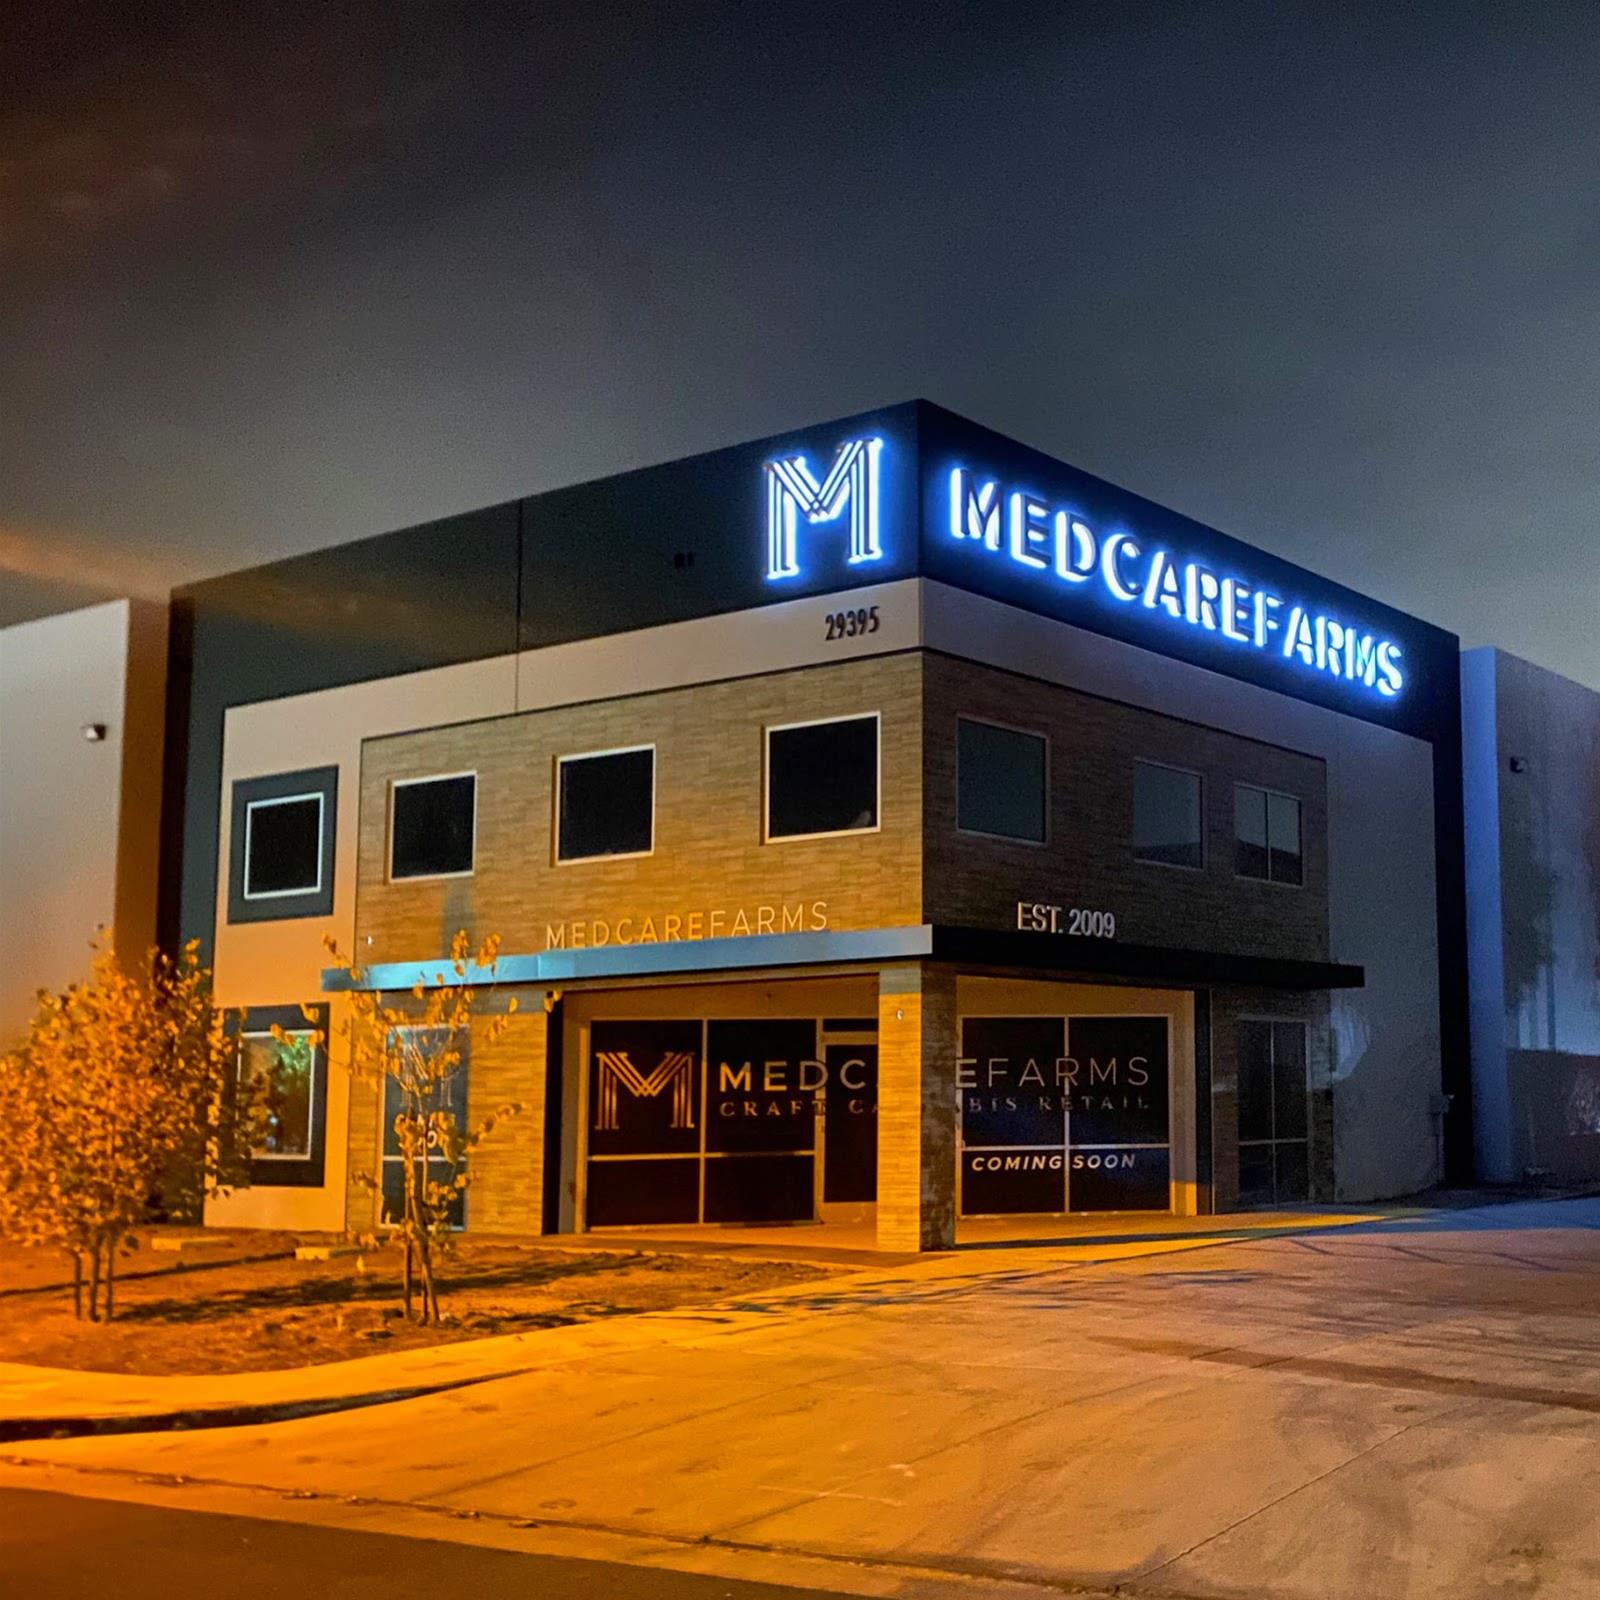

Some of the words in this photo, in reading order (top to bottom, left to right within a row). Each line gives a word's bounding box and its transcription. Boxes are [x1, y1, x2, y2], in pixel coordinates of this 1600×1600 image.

[764, 436, 883, 580] M
[950, 466, 1403, 696] MEDCAREFARMS
[825, 606, 880, 641] 29395
[546, 901, 828, 950] MEDCAREFARMS
[1017, 901, 1063, 934] EST.
[1068, 908, 1116, 938] 2009
[594, 1052, 697, 1131] M
[719, 1099, 827, 1118] CRAFT
[1038, 1095, 1150, 1112] RETAIL
[971, 1155, 1062, 1172] COMING
[1071, 1153, 1137, 1170] SOON
